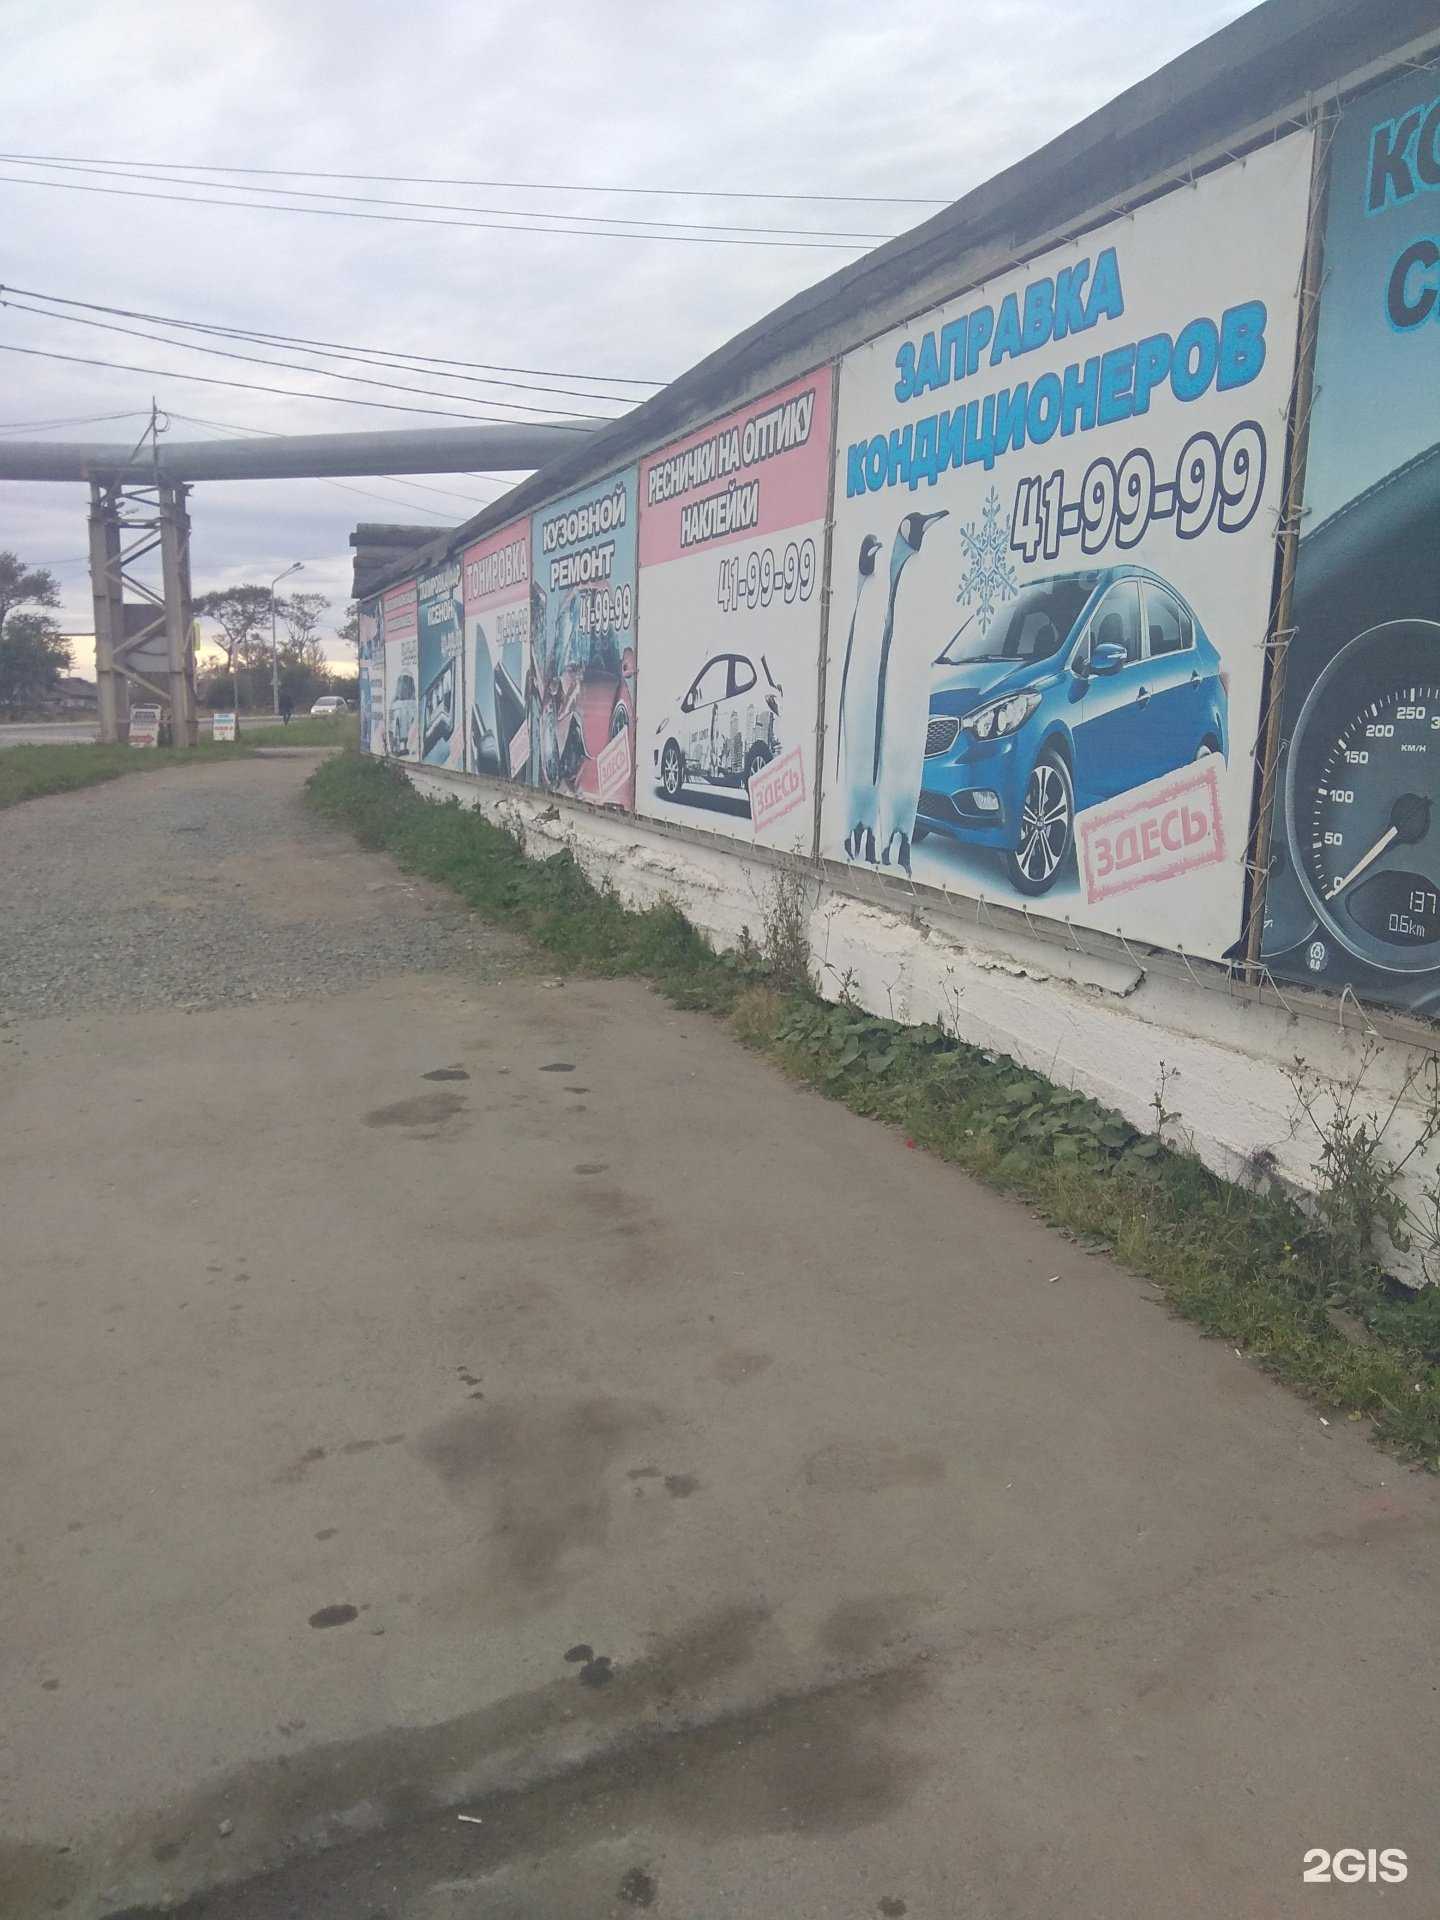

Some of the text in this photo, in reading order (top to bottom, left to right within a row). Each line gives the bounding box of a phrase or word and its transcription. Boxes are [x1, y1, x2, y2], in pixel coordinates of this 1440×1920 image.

[895, 246, 1124, 403] ЗАПРАВКА
[847, 299, 1267, 498] КОНДИЦИОНЕРОВ
[648, 387, 816, 507] РЕСНИЧКИ НА ОПТИКУ
[543, 481, 626, 554] КУЗОВНОЙ
[680, 478, 760, 548] НАКЛЕЙКИ
[1010, 420, 1267, 562] 41-99-99
[465, 538, 528, 601] ТОНИРОВКА
[550, 539, 615, 592] РЕМОНТ
[717, 538, 817, 612] 41-99-99
[579, 584, 632, 635] 41-99-99
[1365, 724, 1395, 738] 200
[1396, 706, 1426, 720] 250
[1344, 750, 1369, 764] 150
[756, 768, 801, 815] ЗДЕСЬ
[1329, 789, 1354, 804] 100
[1094, 805, 1208, 877] ЗДЕСЬ
[1324, 831, 1343, 846] 50
